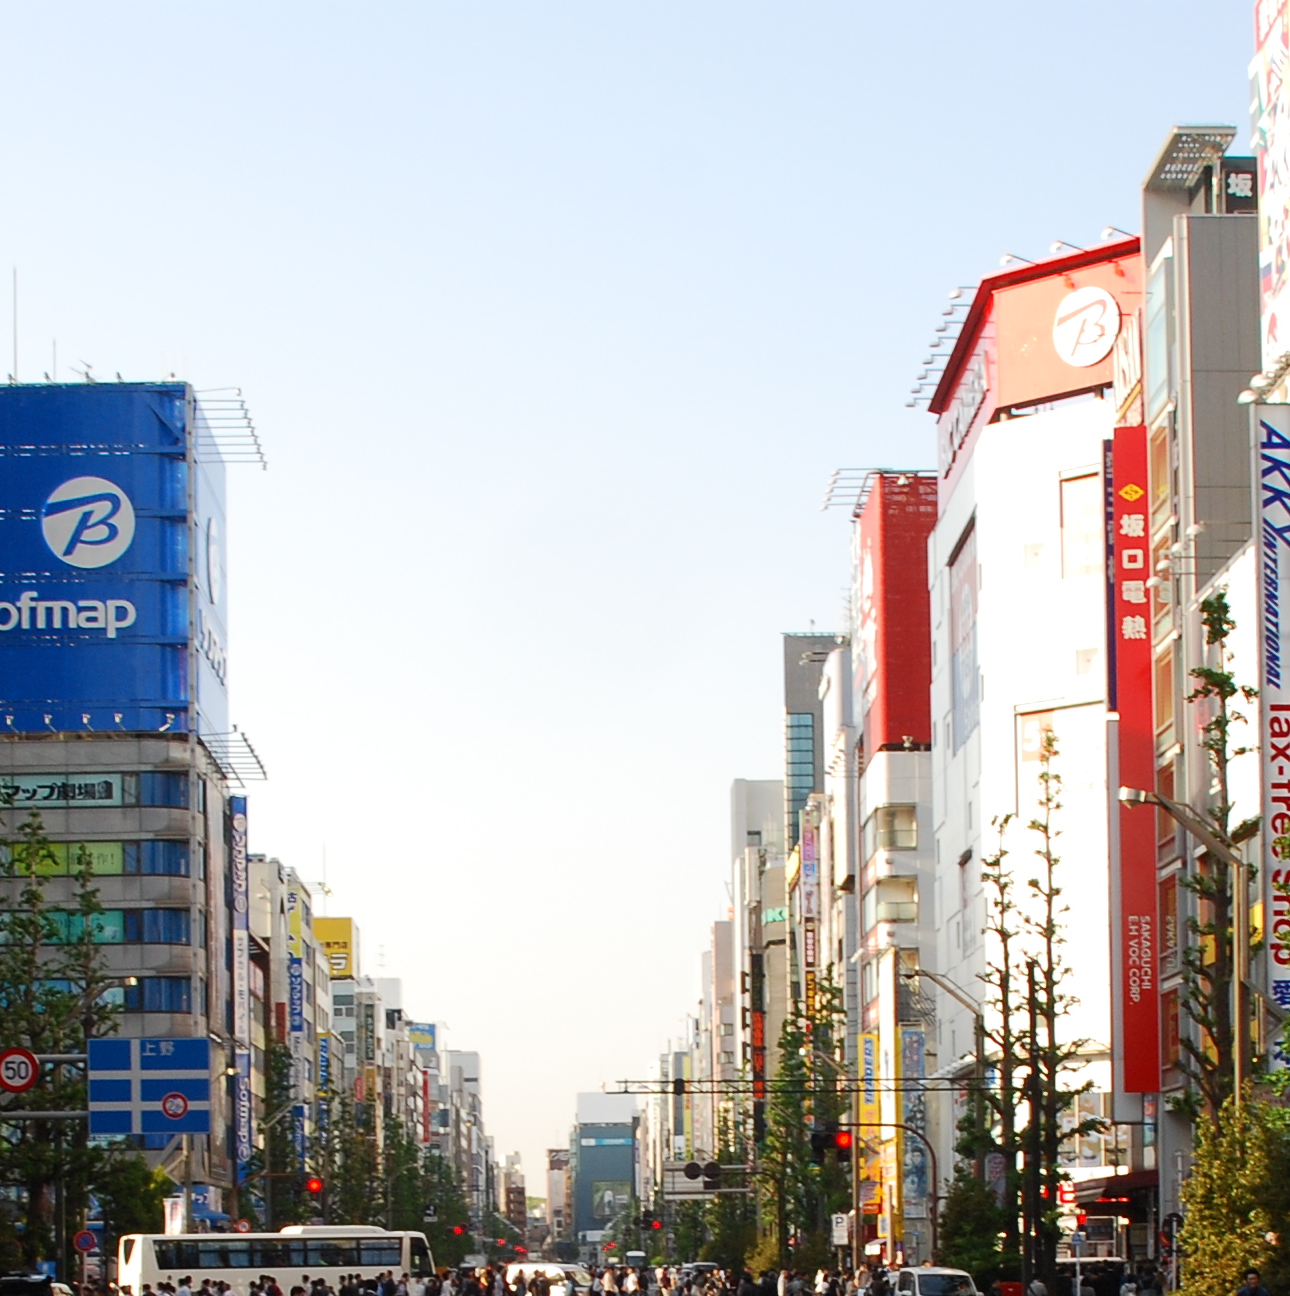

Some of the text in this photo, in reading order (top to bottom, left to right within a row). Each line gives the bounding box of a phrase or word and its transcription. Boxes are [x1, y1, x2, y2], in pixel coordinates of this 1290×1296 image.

[1119, 513, 1147, 640] 坂口電熱
[1262, 526, 1282, 691] INTERNATIONAL
[1128, 939, 1140, 965] VOC
[1140, 916, 1152, 990] SAKAGUCHI
[4, 1060, 29, 1080] 50
[142, 1041, 175, 1056] 上野
